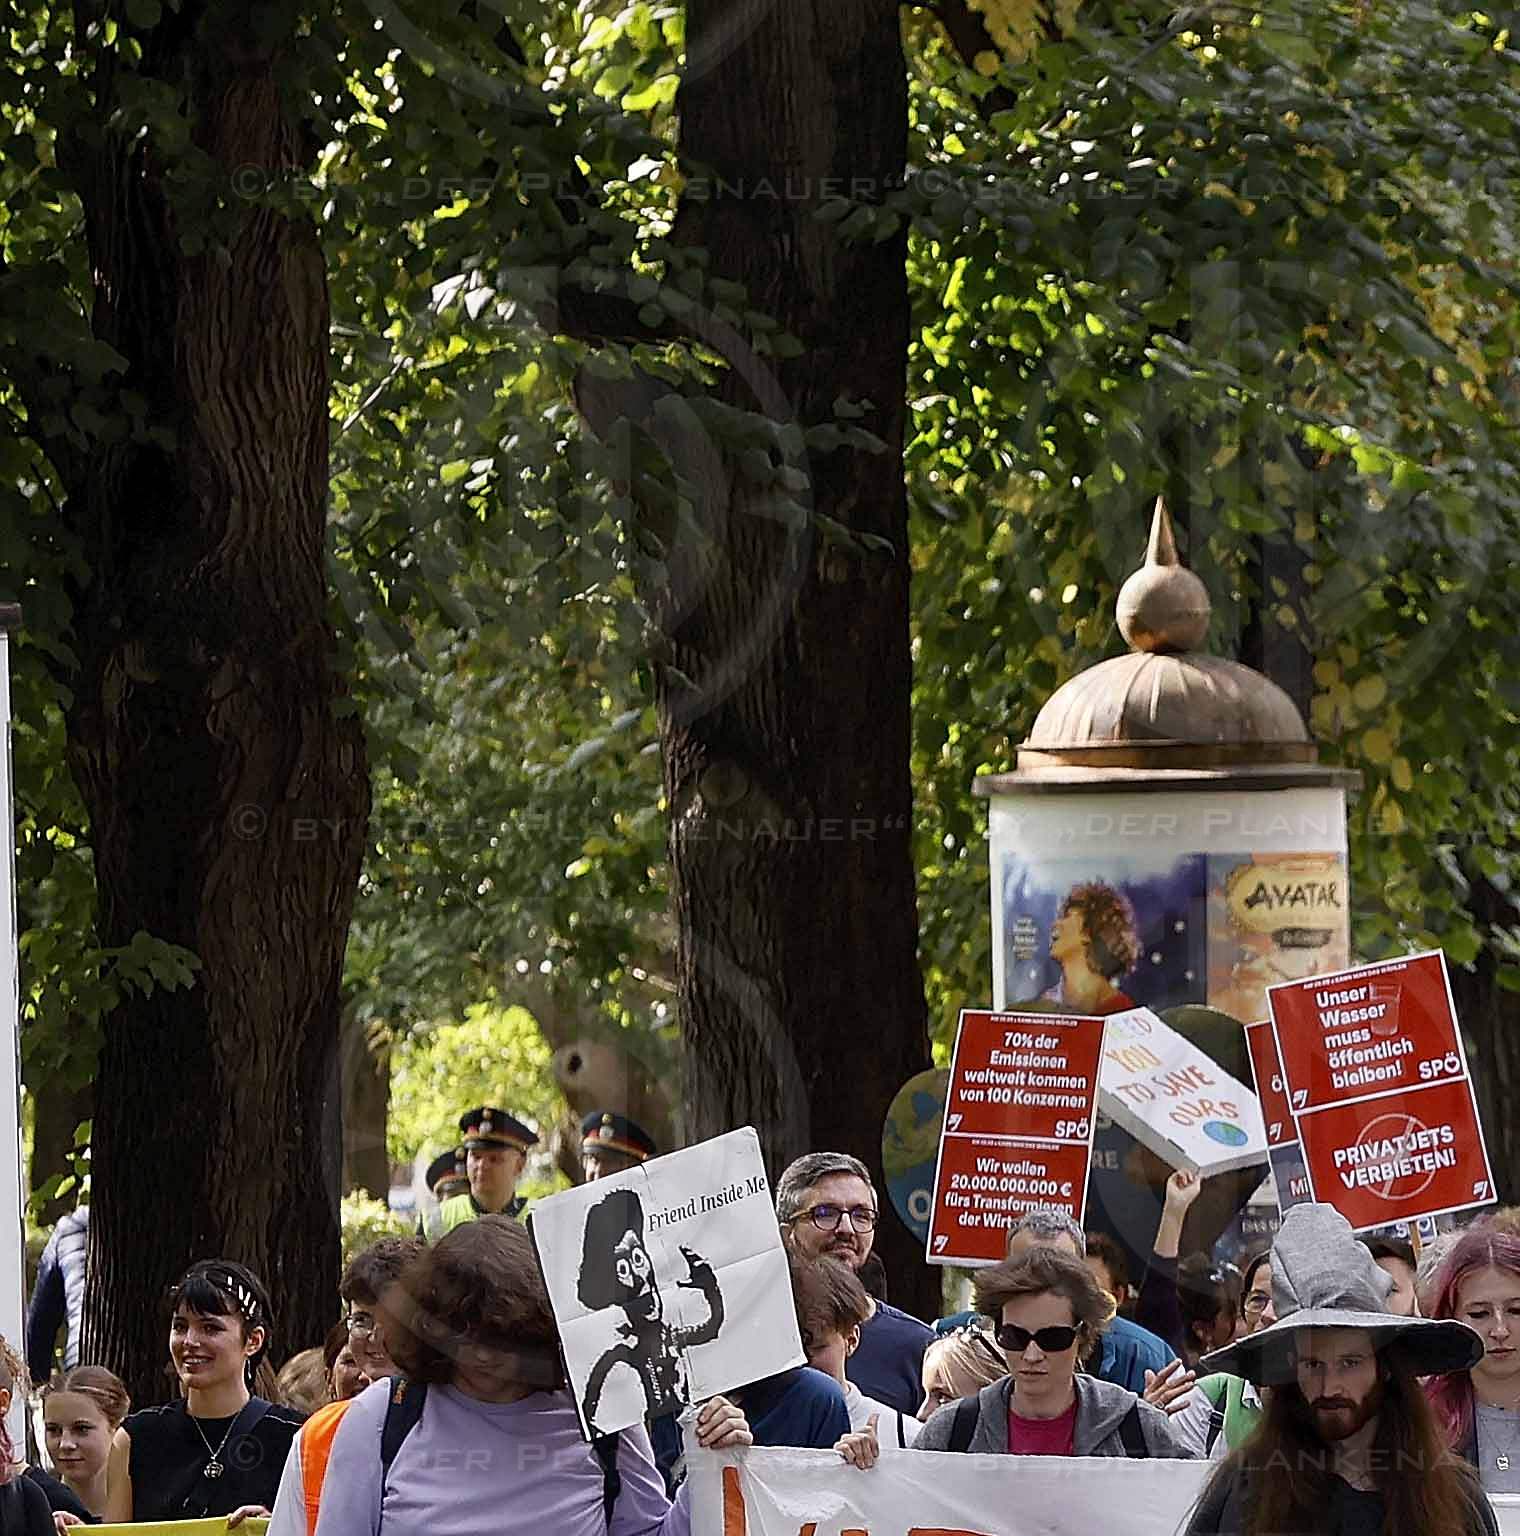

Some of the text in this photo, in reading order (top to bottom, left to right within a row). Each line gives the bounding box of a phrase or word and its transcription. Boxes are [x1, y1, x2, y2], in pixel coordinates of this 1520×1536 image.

[1244, 881, 1342, 910] AVATAR
[1315, 986, 1368, 1008] Unser
[1319, 1003, 1386, 1028] Wasser
[1004, 1032, 1059, 1049] 70% der
[1324, 1027, 1371, 1049] muss
[990, 1051, 1067, 1069] Emissionen
[1105, 1043, 1163, 1073] YOU
[1328, 1037, 1414, 1069] öffentlich
[964, 1069, 1087, 1088] weltweit kommen
[1331, 1060, 1401, 1089] bleiben!
[1418, 1052, 1460, 1080] SPÖ
[1116, 1064, 1216, 1104] TO SAVE
[960, 1088, 1087, 1109] von 100 Konzernen
[1168, 1098, 1239, 1127] OURS
[1054, 1117, 1089, 1138] SPÖ
[1333, 1125, 1454, 1168] PRIVATJETS
[976, 1158, 1046, 1177] Wir wollen
[1340, 1149, 1456, 1189] VERBIETEN!
[950, 1174, 1073, 1197] 20.000.000.000 €
[647, 1175, 767, 1232] Friend Inside Me
[944, 1191, 970, 1208] fürs
[972, 1194, 1074, 1216] Transformieren
[958, 1212, 1013, 1229] der Wirt
